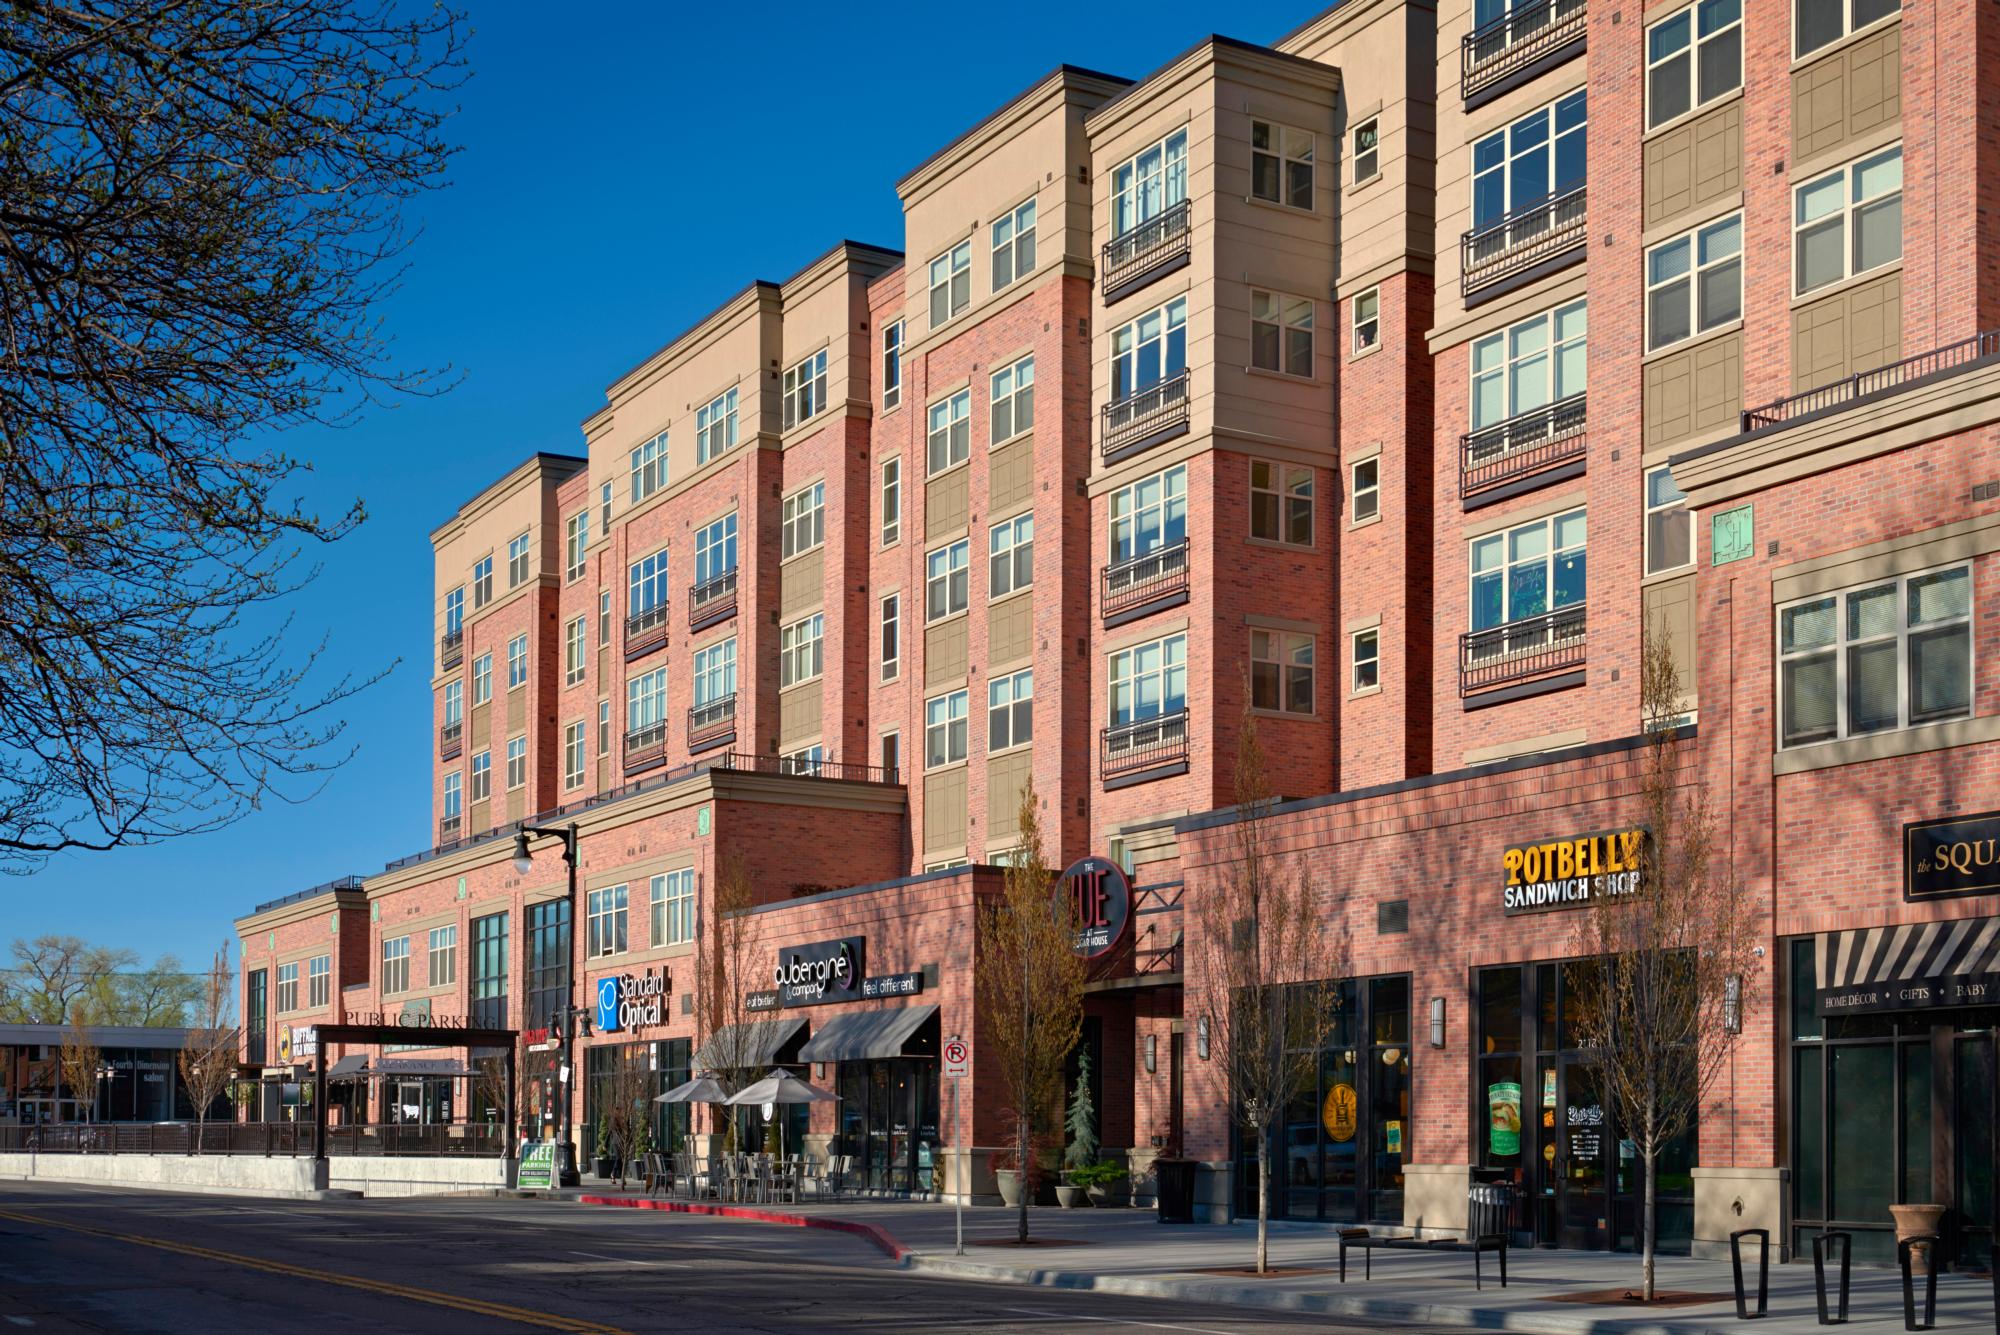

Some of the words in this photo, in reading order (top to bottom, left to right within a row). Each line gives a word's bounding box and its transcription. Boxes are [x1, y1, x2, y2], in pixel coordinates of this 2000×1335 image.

[1504, 830, 1644, 886] POTBELLY
[1917, 859, 1931, 874] the
[1935, 839, 2000, 875] SQU
[1084, 863, 1094, 872] THE
[1504, 878, 1589, 908] SANDWICH
[1594, 872, 1641, 897] SHOP
[1087, 929, 1093, 937] AT
[1091, 936, 1108, 946] HOUSE
[619, 965, 664, 999] Standard
[775, 954, 847, 992] aubergine
[792, 982, 825, 1000] company
[863, 979, 878, 995] feel
[880, 976, 914, 993] different
[1825, 995, 1847, 1008] HOME
[1848, 992, 1877, 1006] DÉCOR
[1900, 987, 1929, 1000] GIFTS
[1957, 984, 1988, 997] BABY
[345, 1011, 410, 1028] PUBLIC
[418, 1014, 496, 1031] PARKING
[619, 995, 661, 1035] Optical
[1578, 1039, 1598, 1049] 212
[113, 1060, 134, 1070] Fourth
[137, 1060, 170, 1070] Dimension
[144, 1072, 165, 1082] salon
[523, 1146, 552, 1161] FREE
